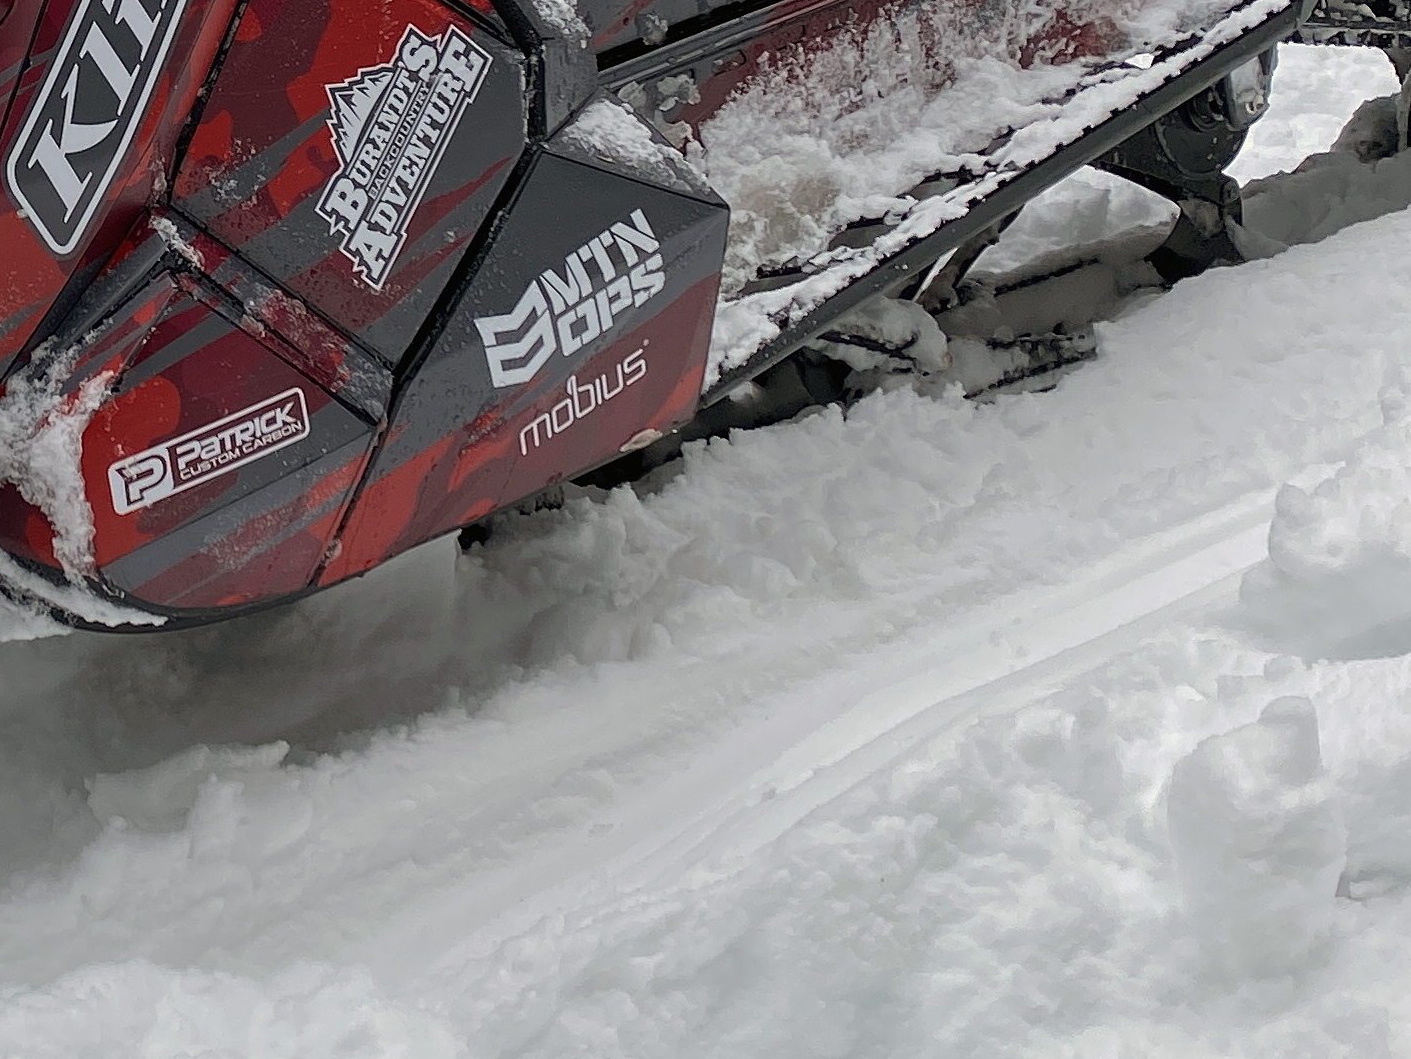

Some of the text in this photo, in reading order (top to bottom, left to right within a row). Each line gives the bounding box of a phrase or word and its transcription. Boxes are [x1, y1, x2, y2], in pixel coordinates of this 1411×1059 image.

[350, 36, 486, 280] ADVENTURE
[368, 84, 429, 200] BACKCOUNTRY
[539, 208, 660, 315] MTN
[557, 253, 666, 357] OPS
[179, 420, 303, 481] CUSTOM CARBON
